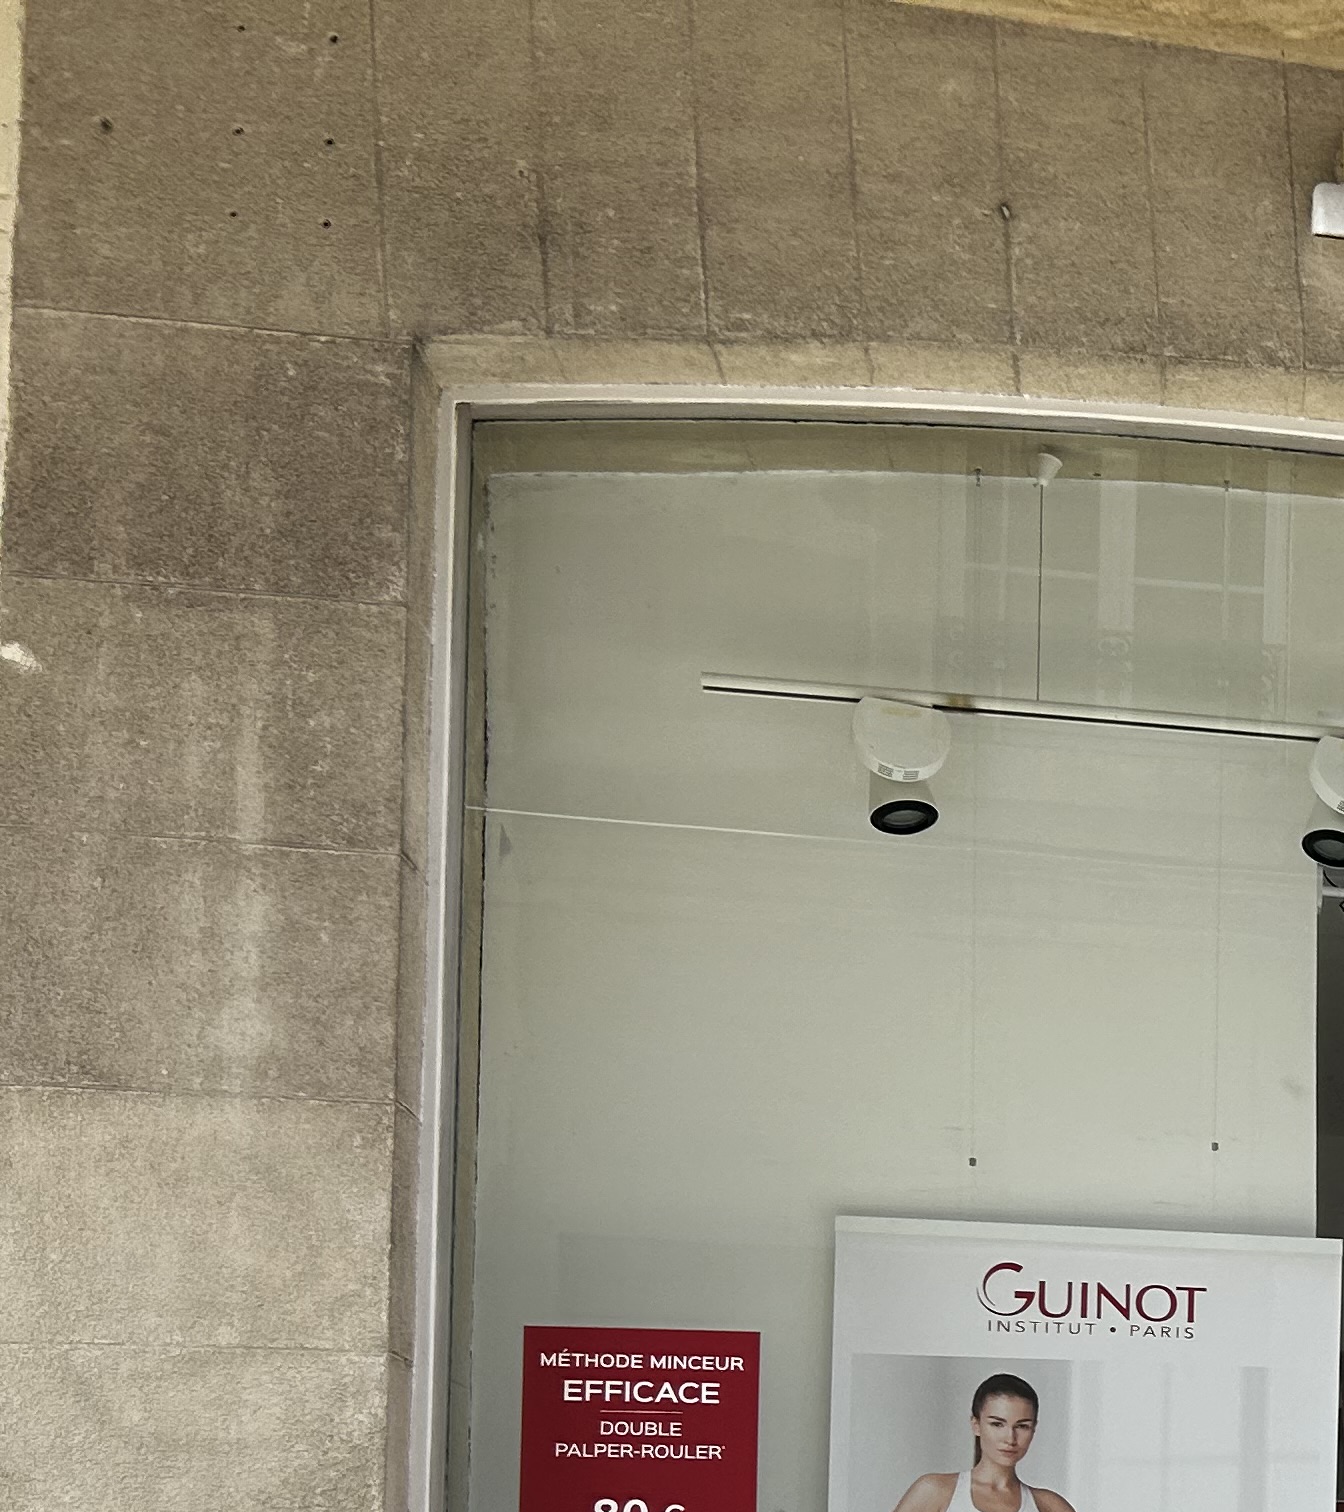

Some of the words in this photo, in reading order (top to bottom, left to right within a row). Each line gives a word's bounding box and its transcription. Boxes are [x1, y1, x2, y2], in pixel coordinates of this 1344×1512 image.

[975, 1261, 1208, 1324] GUINOT
[987, 1319, 1096, 1336] INSTITUT
[1129, 1324, 1195, 1340] PARIS
[540, 1348, 643, 1369] MÉTHODE
[650, 1354, 745, 1371] MINCEUR
[563, 1379, 720, 1405] EFFICACE
[600, 1420, 682, 1437] DOUBLE
